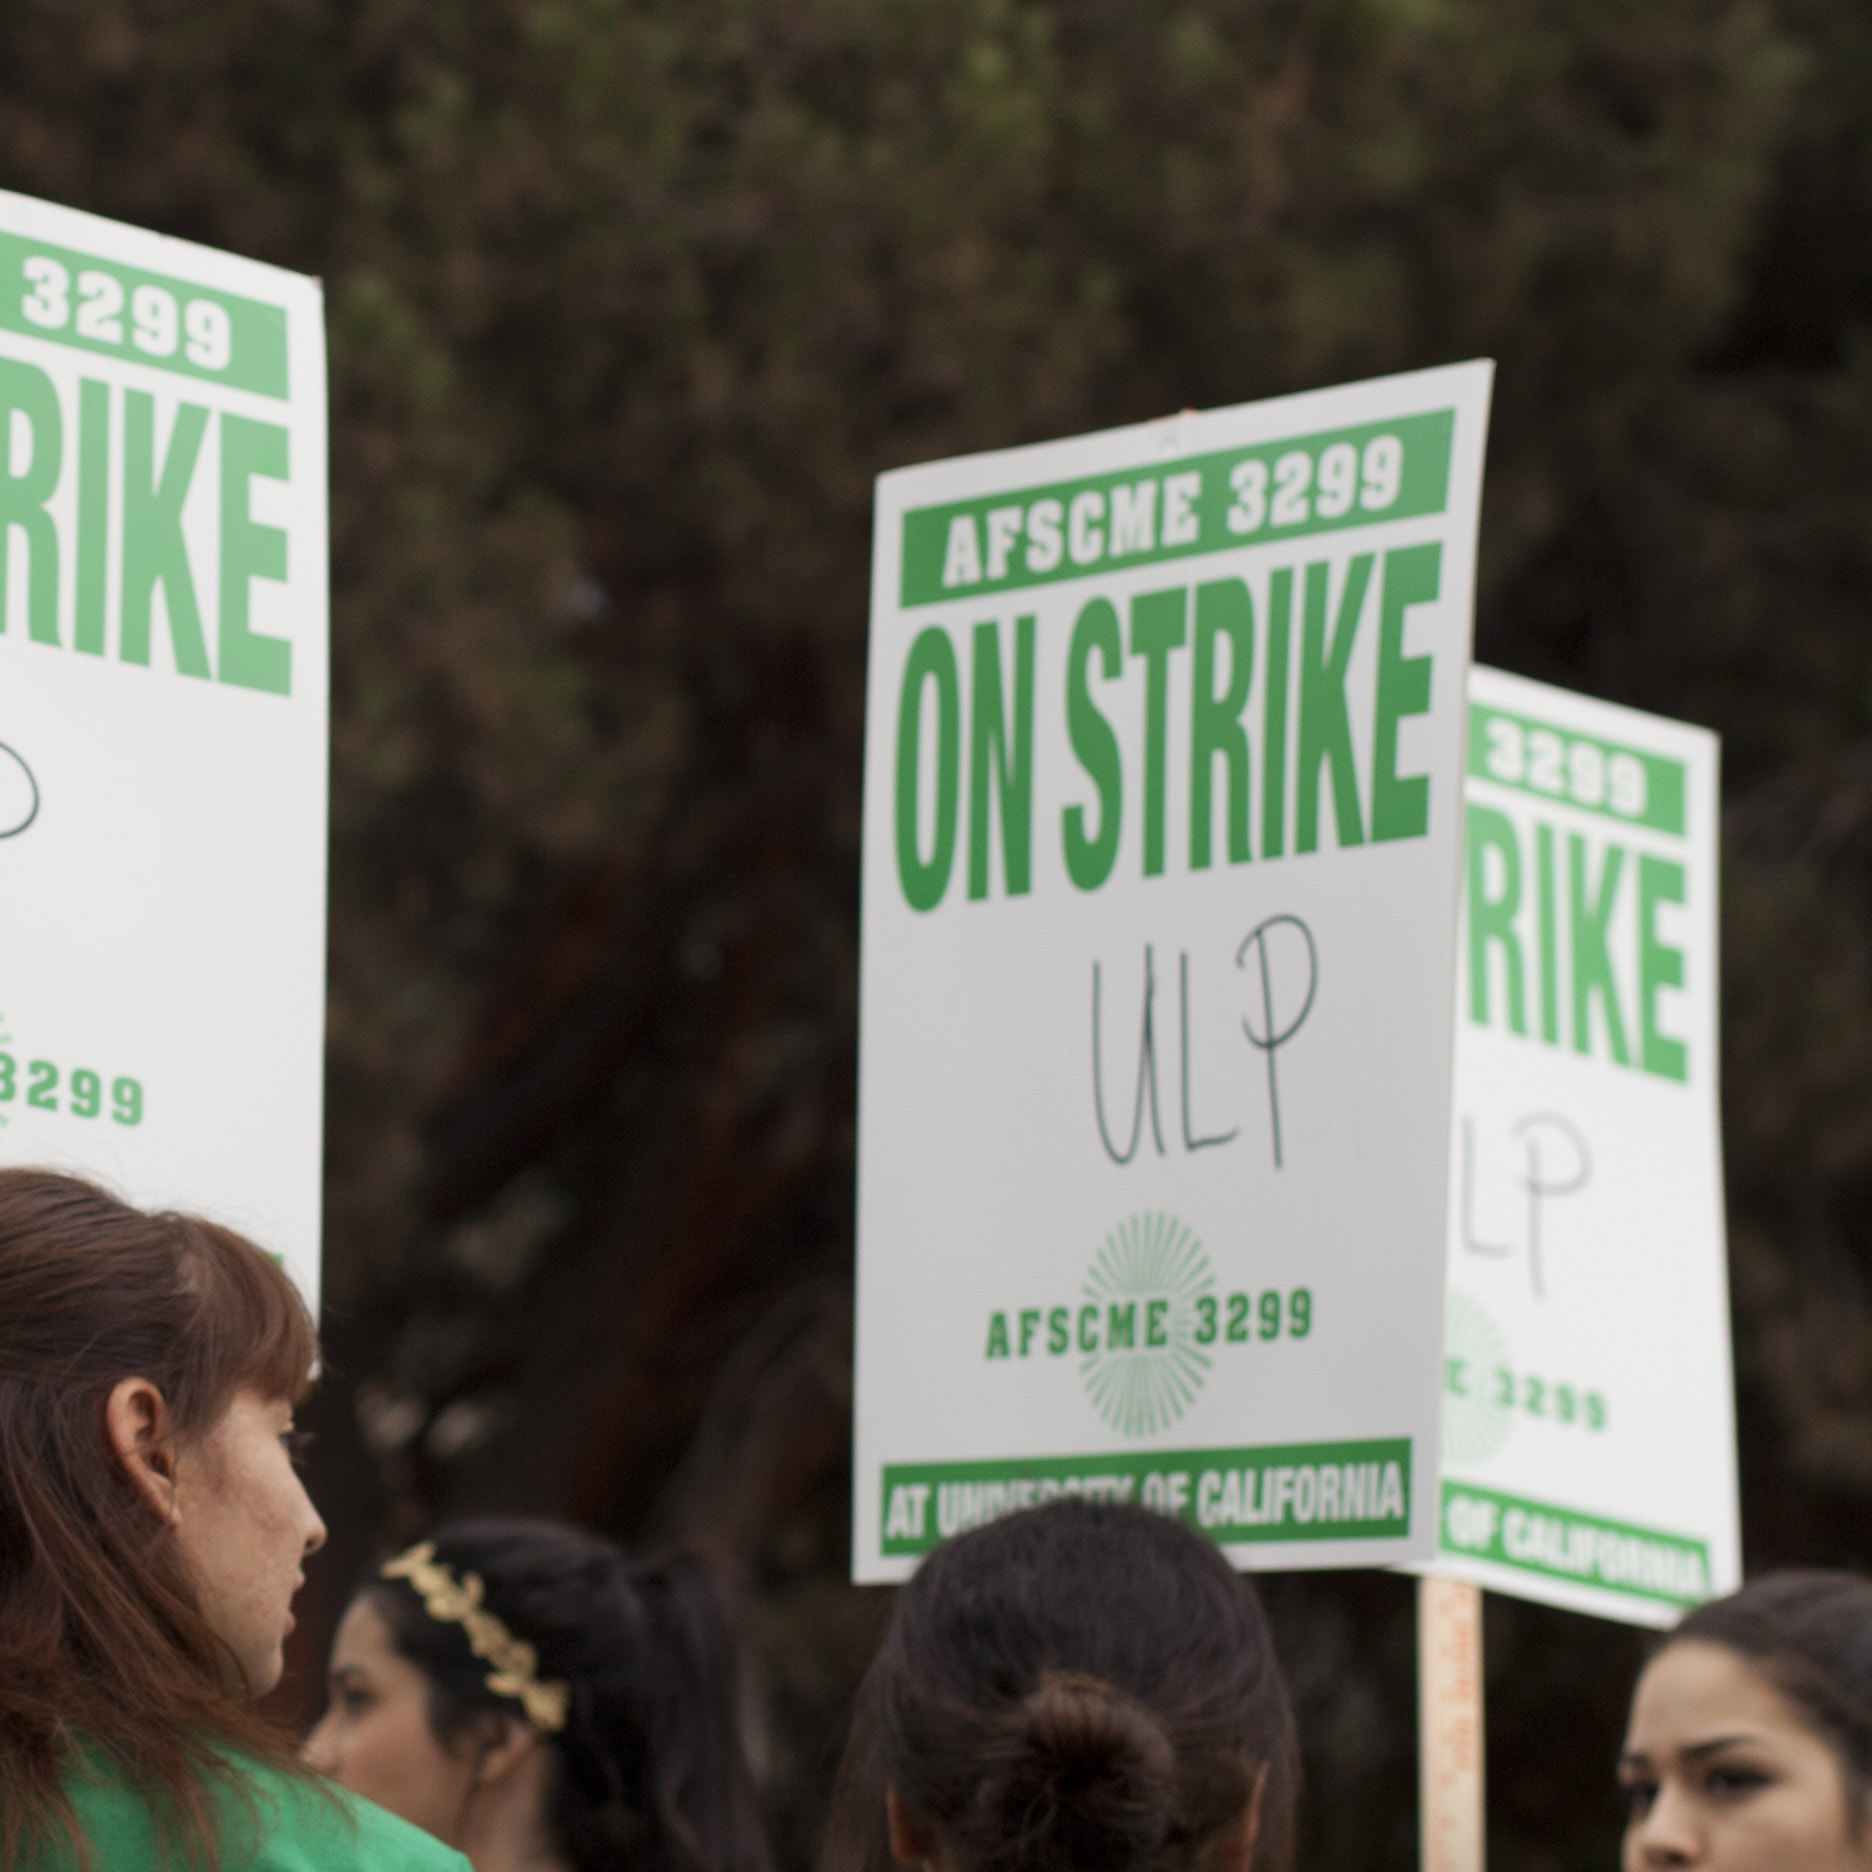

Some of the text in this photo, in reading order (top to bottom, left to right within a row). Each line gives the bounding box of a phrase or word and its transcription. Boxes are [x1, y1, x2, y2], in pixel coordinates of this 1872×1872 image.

[21, 255, 232, 371] 3299
[943, 434, 1404, 588] AFSCME 3299
[893, 539, 1444, 914] ON STRIKE
[1484, 716, 1649, 819] 3299
[1091, 914, 1318, 1170] ULP
[984, 1286, 1314, 1360] AFSCME 3299
[886, 1484, 932, 1539] AT
[1196, 1462, 1406, 1526] CALIFORNIA
